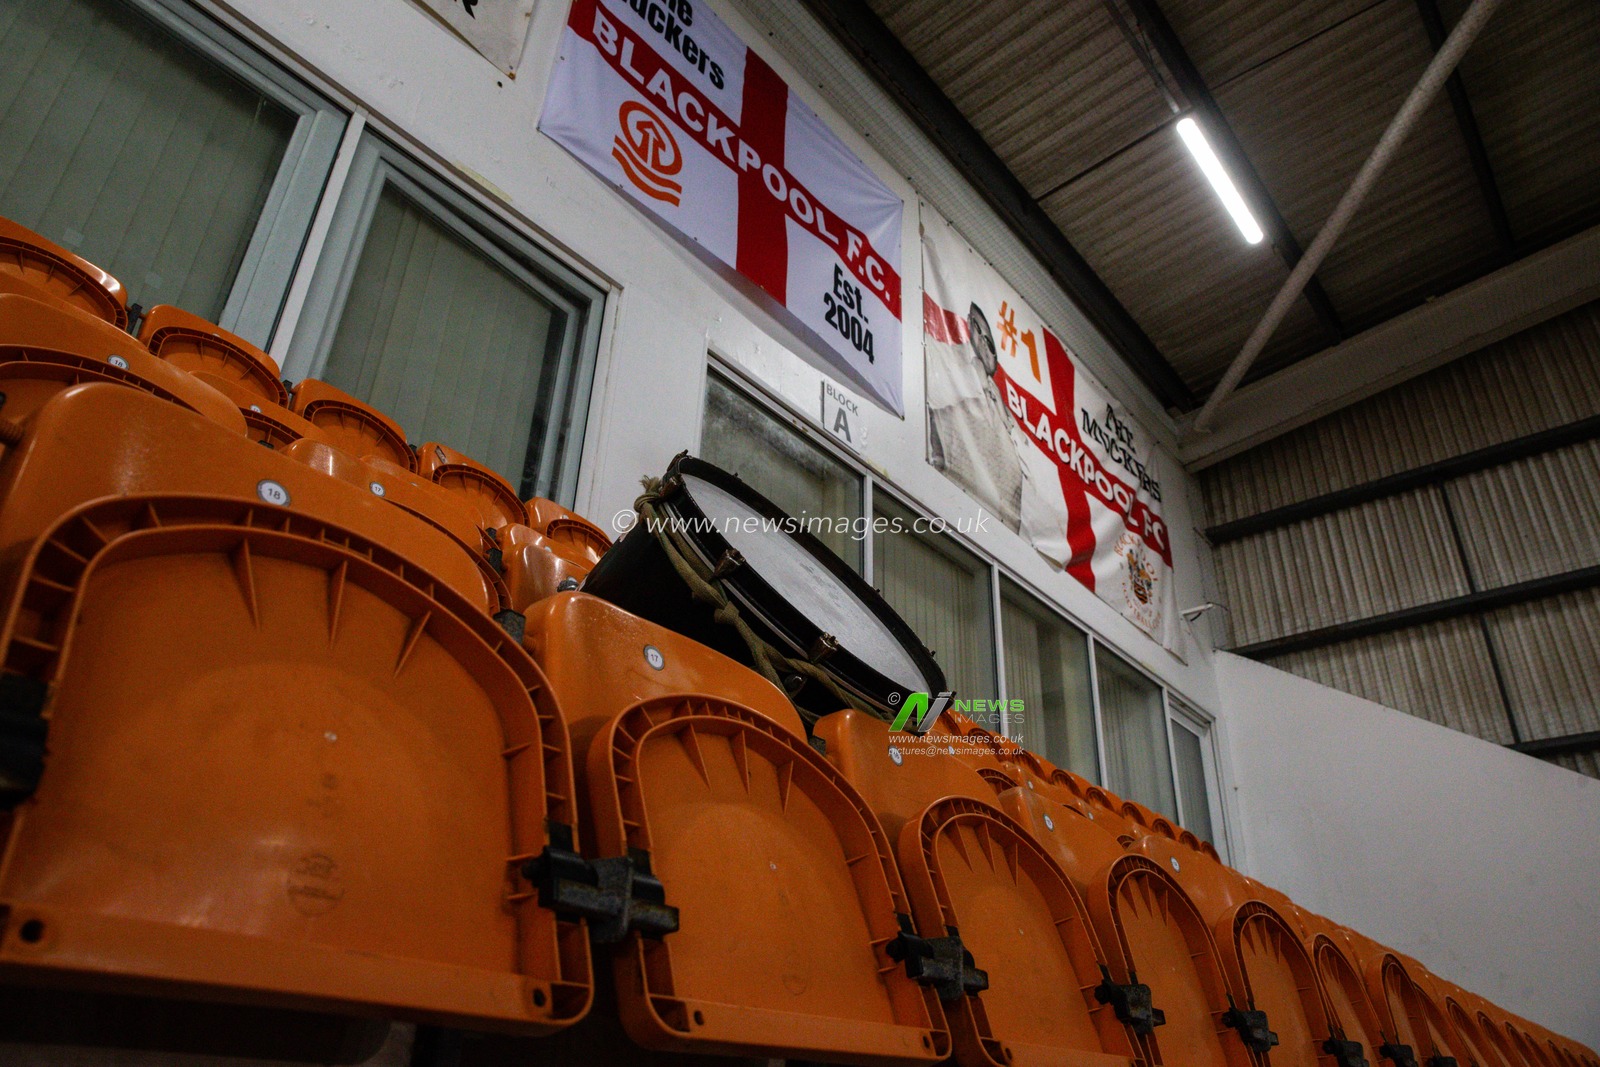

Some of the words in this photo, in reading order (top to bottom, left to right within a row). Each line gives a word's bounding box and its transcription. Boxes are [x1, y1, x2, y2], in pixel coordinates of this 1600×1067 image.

[624, 0, 725, 91] uckers
[592, 4, 839, 244] BLACKPOOL
[846, 229, 891, 302] F.C.
[823, 291, 875, 365] 2004
[832, 262, 870, 325] Est.
[996, 299, 1042, 385] #1
[826, 382, 859, 417] BLOCK
[833, 406, 853, 444] A
[1004, 378, 1140, 528] BLACKPOOL
[1141, 508, 1166, 551] FC
